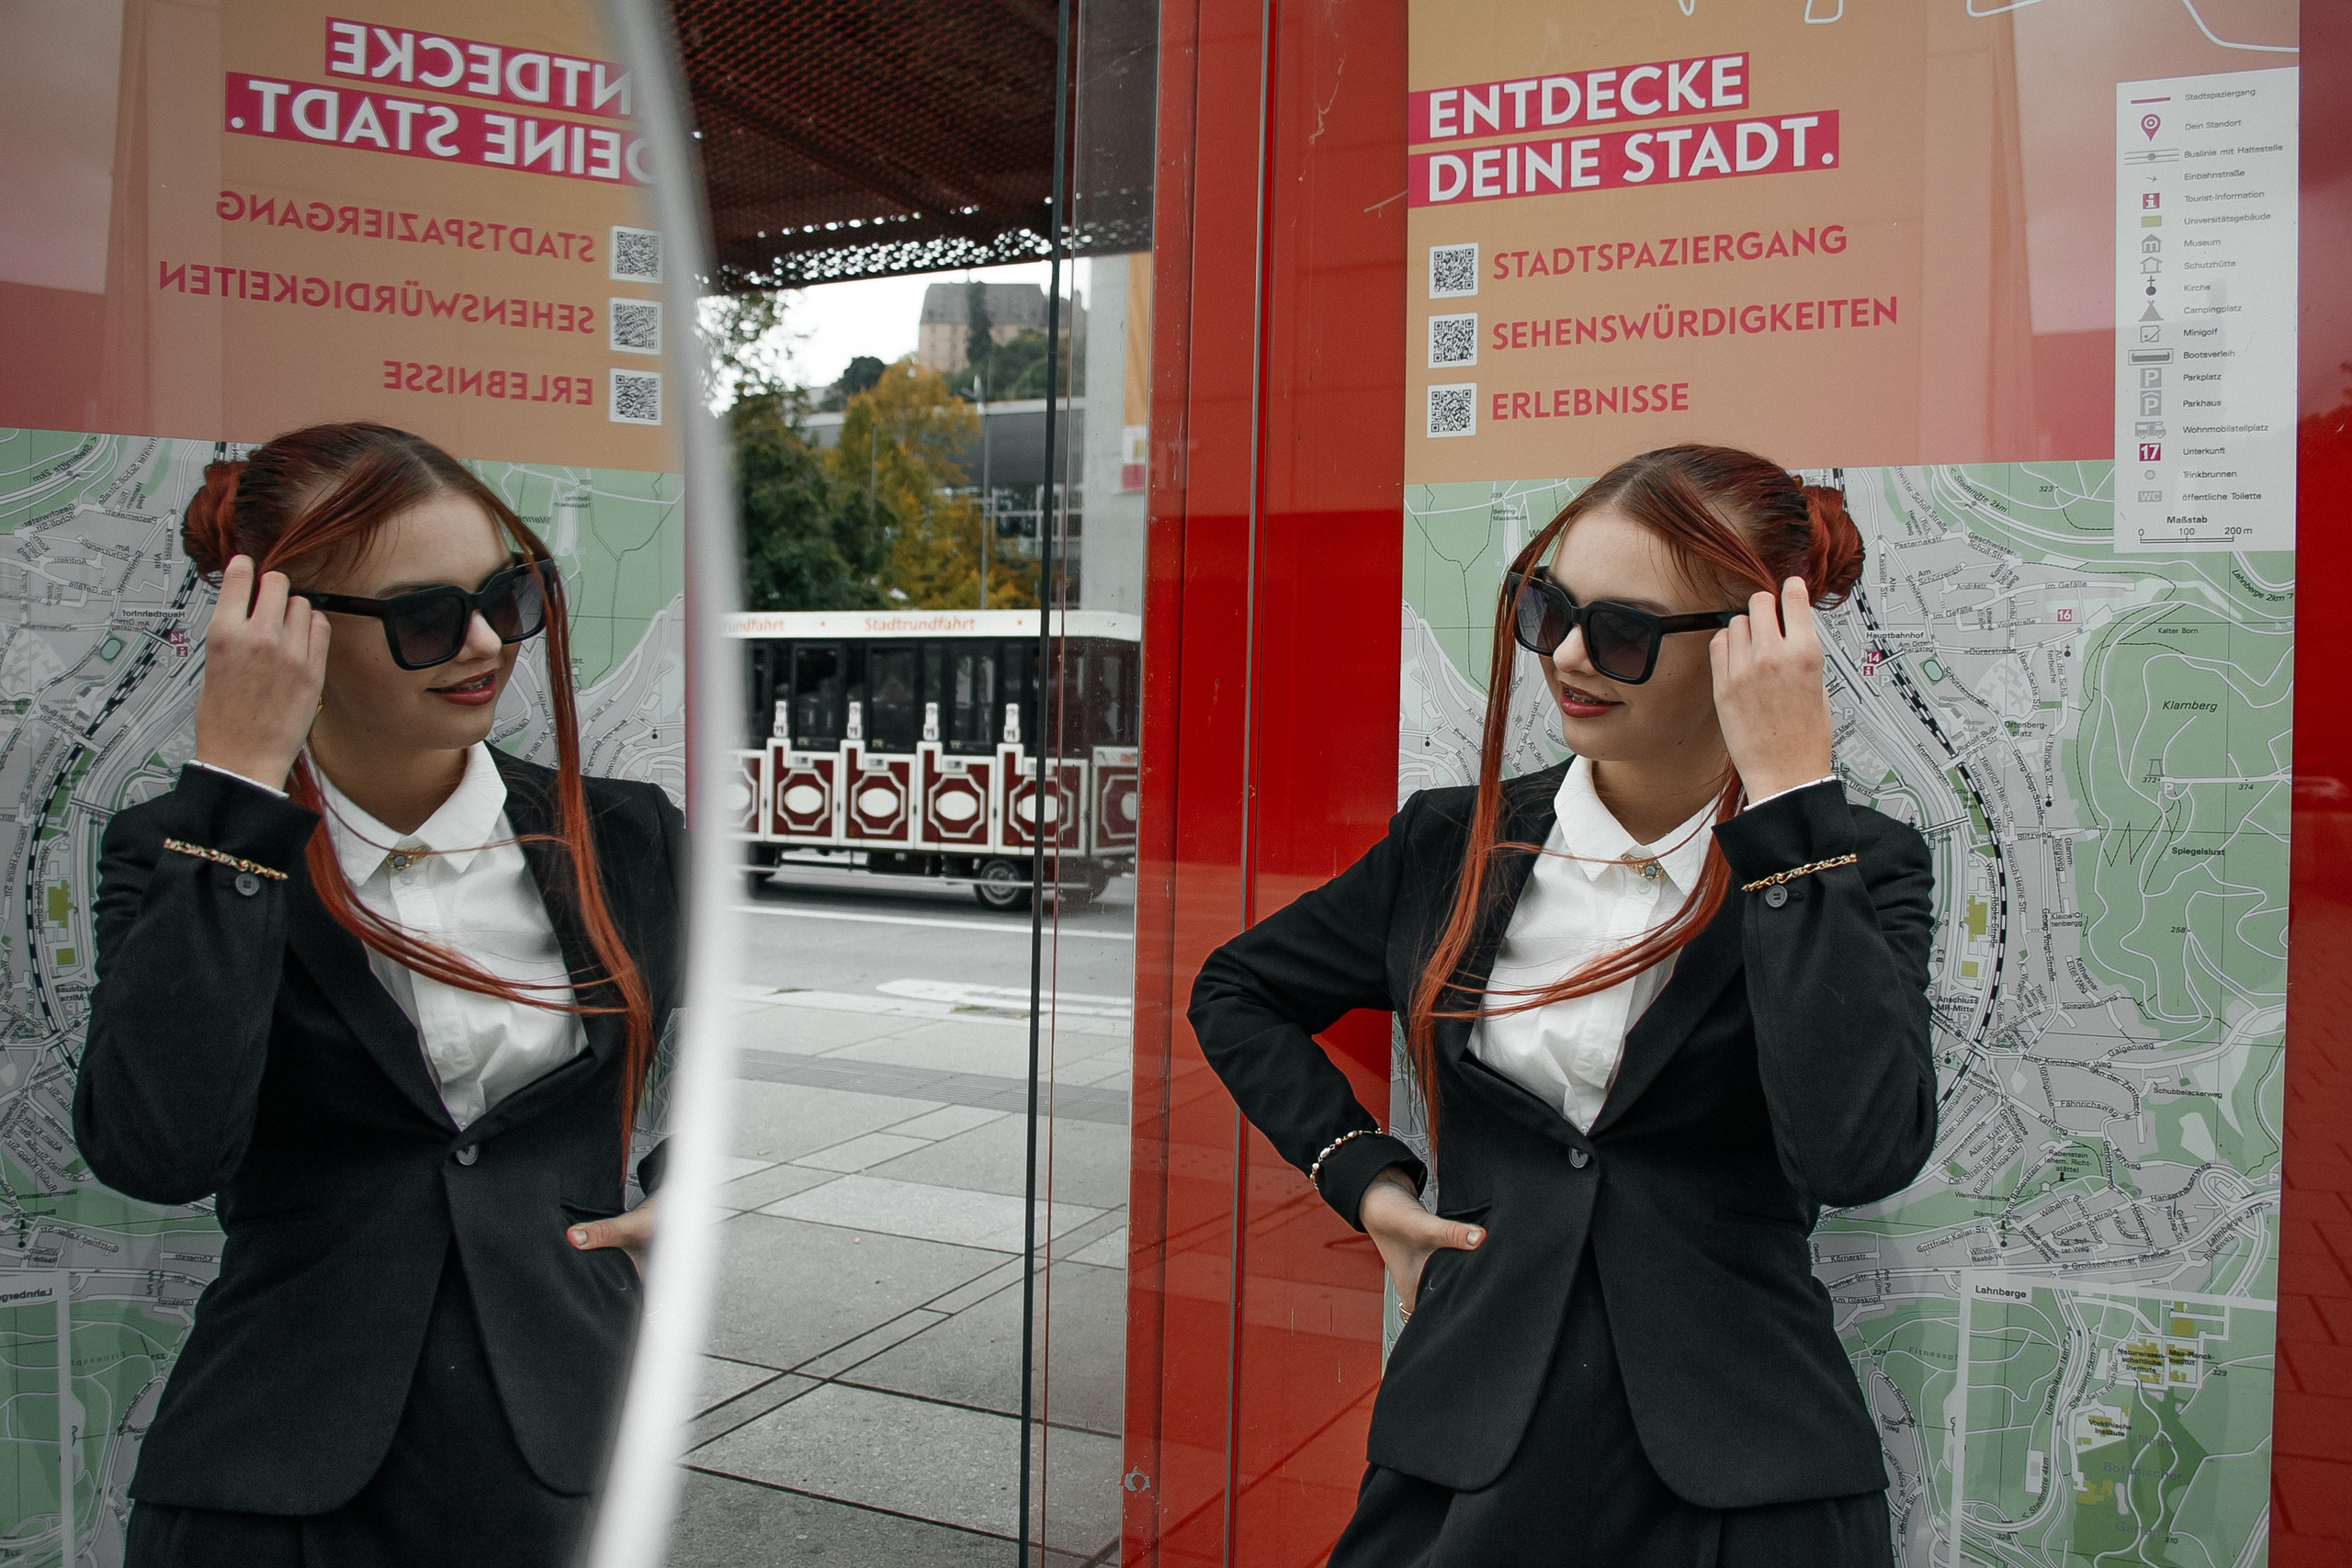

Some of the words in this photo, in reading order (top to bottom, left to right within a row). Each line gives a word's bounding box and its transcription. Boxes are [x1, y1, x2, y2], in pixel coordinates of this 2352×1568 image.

[1428, 55, 1744, 139] ENTDECKE
[2185, 88, 2256, 101] Stadtspaziergang
[2185, 122, 2203, 130] Dein
[2206, 119, 2242, 129] Standort
[2184, 149, 2217, 159] Buslinie
[2237, 144, 2283, 154] Haltestelle
[1428, 138, 1601, 202] DEINE
[1622, 116, 1834, 183] STADT.
[2184, 170, 2245, 181] Einbahnstraße
[2184, 191, 2265, 203] Tourist-Information
[2184, 213, 2271, 226] Universitätsgebäude
[2184, 239, 2221, 247] Museum
[1492, 225, 1849, 280] STADTSPAZIERGANG
[2184, 260, 2236, 270] Schutzhütte
[2184, 284, 2211, 292] Kirche
[2184, 305, 2242, 315] Campingplatz
[1491, 297, 1898, 350] SEHENSWÜRDIGKEITEN
[2184, 329, 2218, 337] Minigolf
[2183, 350, 2235, 358] Bootsverleih
[1491, 383, 1689, 421] ERLEBNISSE
[2183, 423, 2268, 434] Wohnmobilstellplatz
[2142, 445, 2159, 459] 17
[1954, 474, 1989, 503] Stadtmitte
[1989, 499, 2007, 513] 2km
[2182, 492, 2227, 501] öffentliche
[2166, 515, 2208, 524] Maßstab
[2178, 527, 2195, 536] 100
[2224, 526, 2242, 535] 200
[1894, 536, 1944, 549] Pasternakstr.
[1968, 531, 2017, 556] Geschwister-
[1967, 539, 2005, 561] Scholl-Str.
[1917, 570, 1931, 578] Am
[2058, 581, 2087, 589] Gefälle
[2232, 569, 2265, 599] Lahnberge
[2058, 611, 2071, 619] 16
[722, 618, 786, 632] rundfahrt
[865, 616, 976, 632] Stadtrundfahrt
[1867, 652, 1881, 662] 14
[2162, 701, 2218, 712] Klamberg
[2004, 721, 2048, 729] Ortenberg-
[2012, 729, 2032, 738] platz
[2172, 847, 2225, 857] Spiegelslust
[2075, 957, 2098, 991] Katharina-
[1938, 996, 1978, 1004] Anschluss
[2108, 1043, 2154, 1056] Galgenweg
[2154, 1088, 2222, 1099] Schubbelackerweg
[2049, 1149, 2088, 1158] Rabenstein
[2206, 1216, 2244, 1247] Lahnberge
[1975, 1285, 2027, 1299] Lahnberge
[2069, 1371, 2092, 1410] Stadtmitte
[2095, 1428, 2125, 1437] Institute
